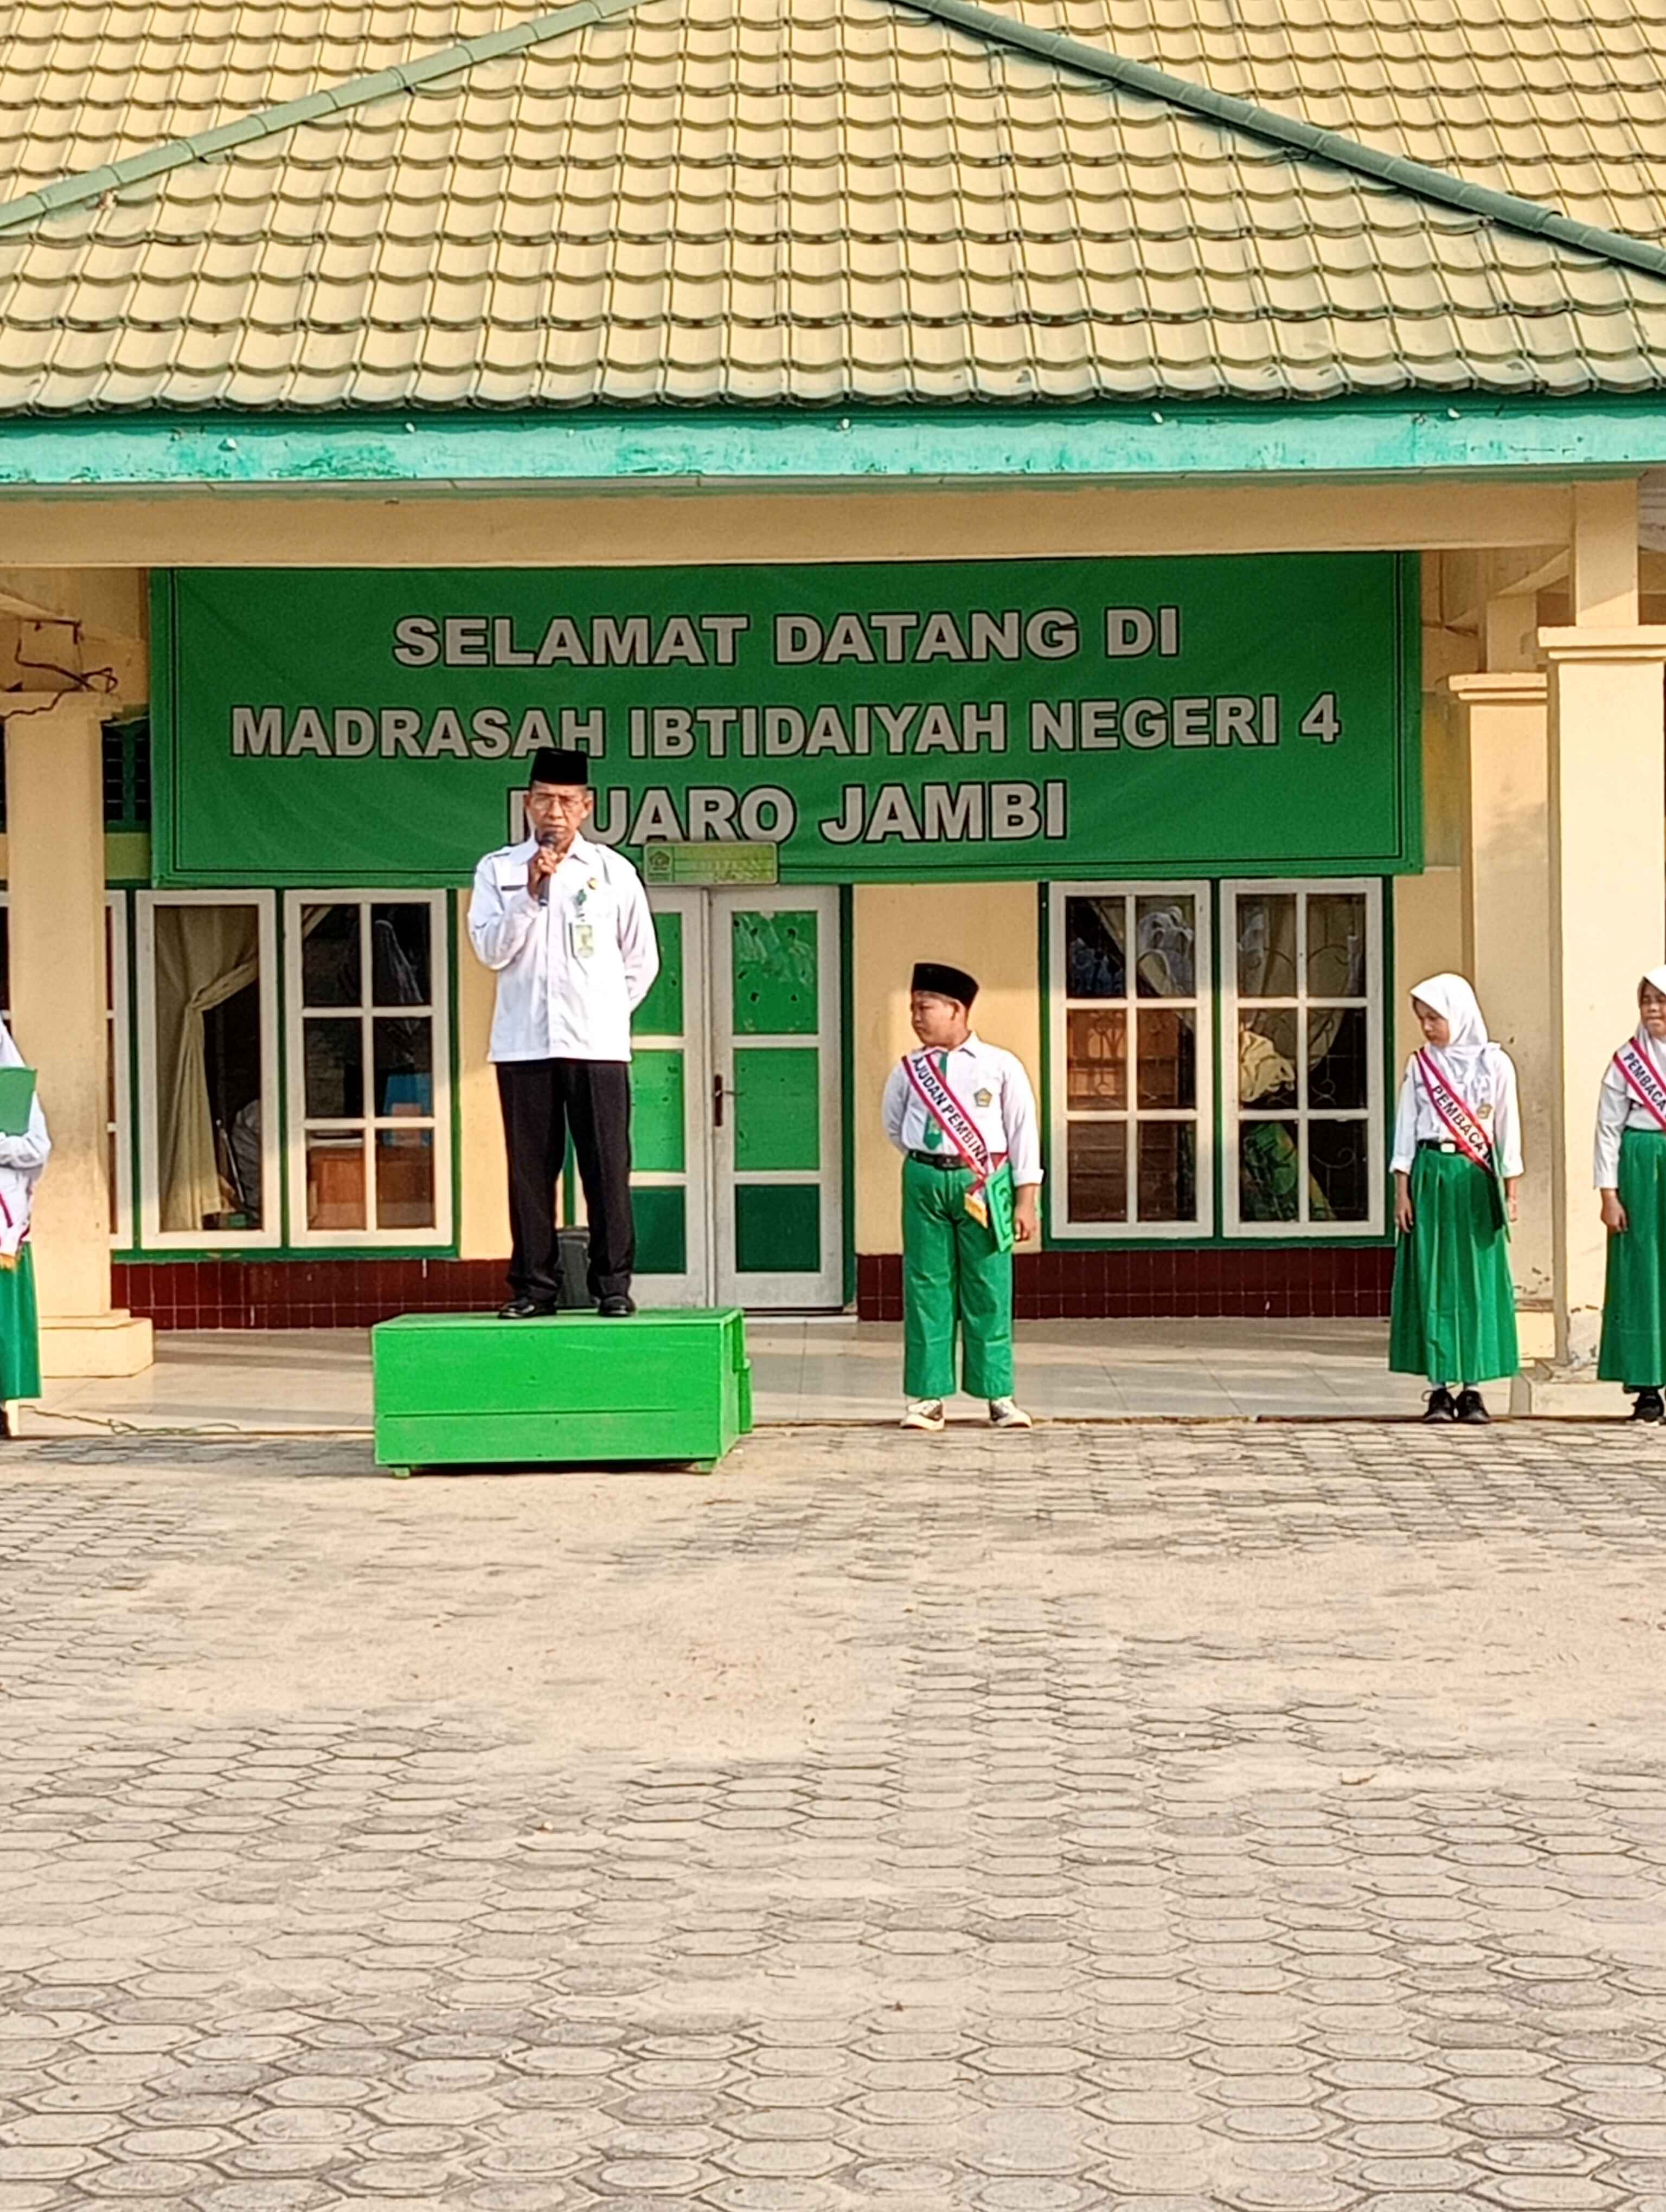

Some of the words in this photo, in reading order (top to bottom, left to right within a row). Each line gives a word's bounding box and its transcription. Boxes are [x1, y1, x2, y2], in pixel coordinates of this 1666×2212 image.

[393, 614, 750, 667] SELAMAT
[774, 608, 1079, 665] DATANG
[1104, 606, 1179, 658] DI
[230, 705, 605, 759] MADRASAH
[629, 702, 1008, 758] IBTIDAIYAH
[1029, 694, 1280, 752] NEGERI
[1299, 692, 1342, 744] 4
[820, 780, 1068, 845] JAMBI
[912, 1057, 948, 1106] AJUDAN
[941, 1103, 989, 1167] PEMBINA
[1623, 1052, 1666, 1111] PEMBACA
[1432, 1085, 1484, 1153] PEMBACA
